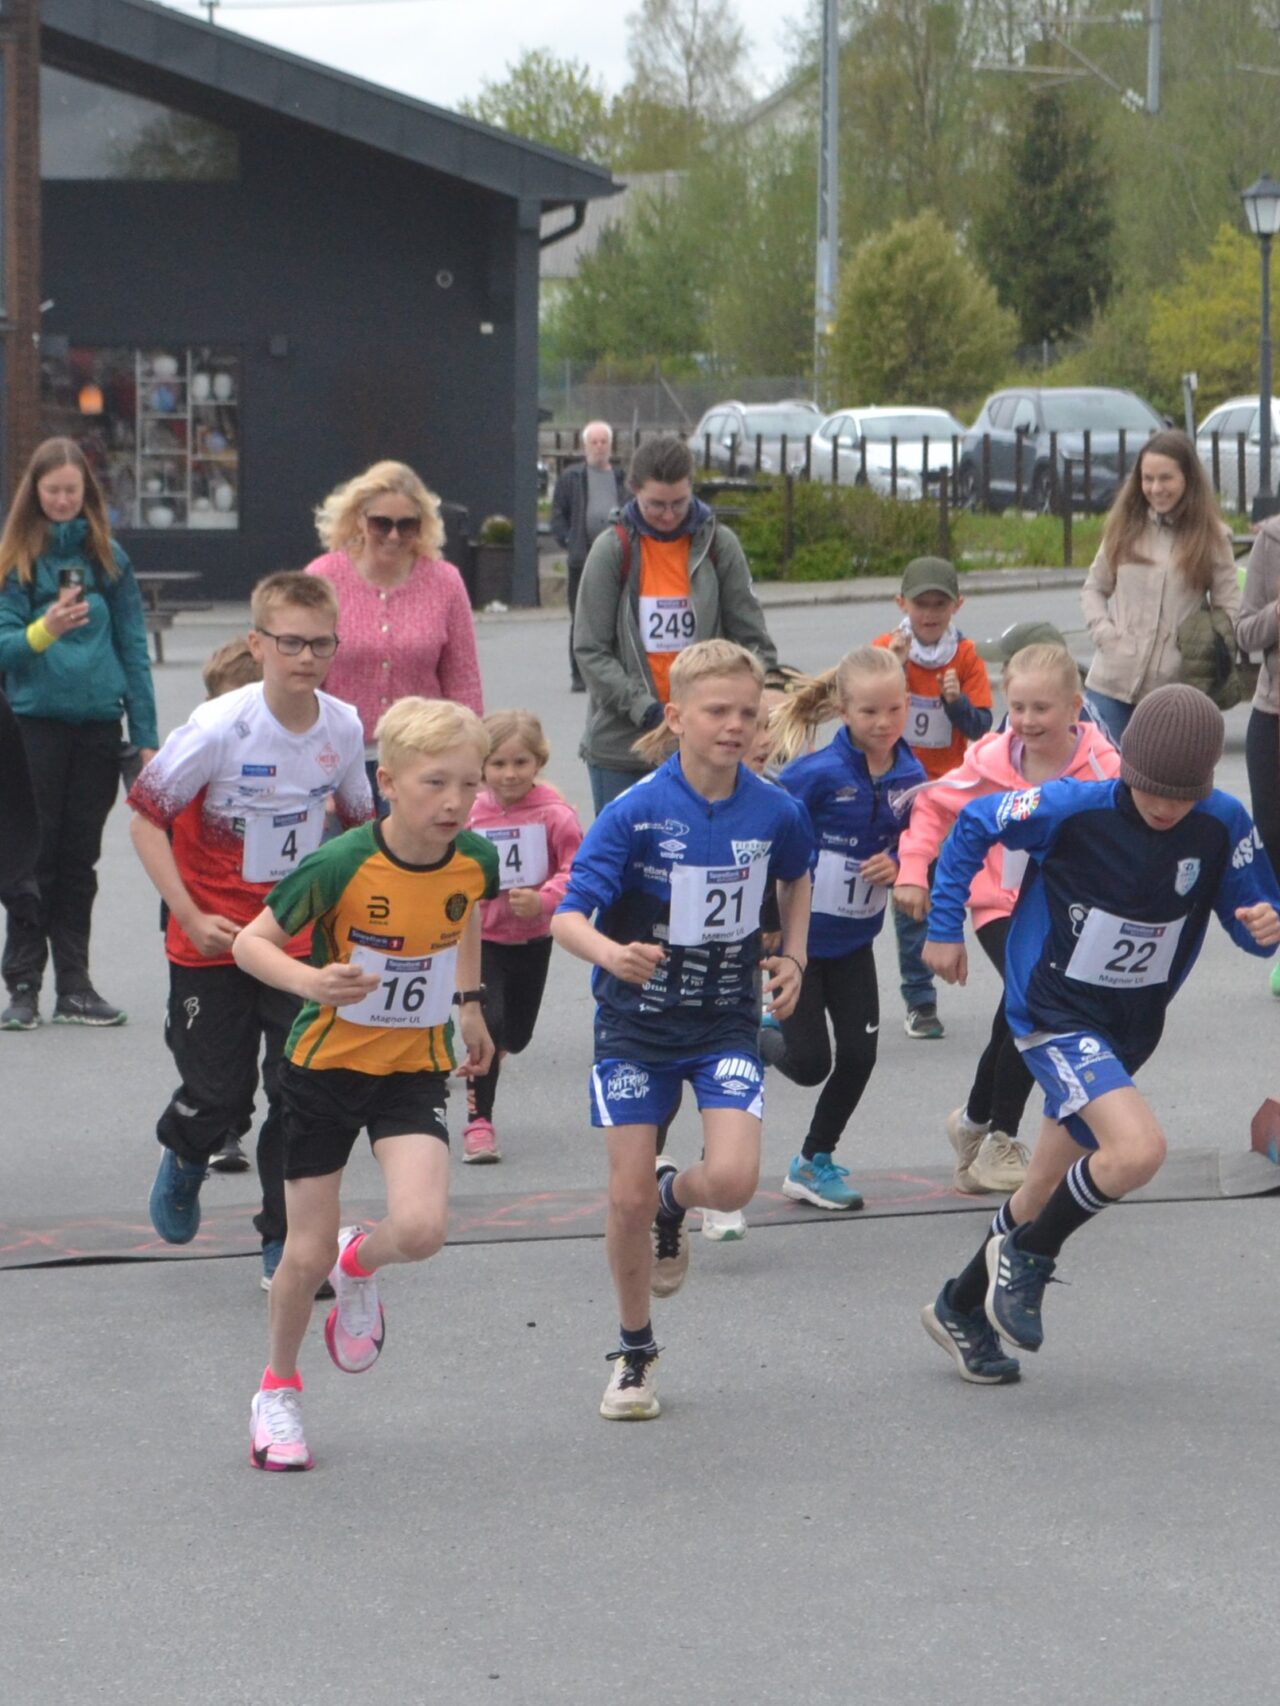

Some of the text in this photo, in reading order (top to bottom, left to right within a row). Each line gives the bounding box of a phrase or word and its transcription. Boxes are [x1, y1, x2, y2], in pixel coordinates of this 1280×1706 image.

[649, 610, 695, 638] 249
[914, 712, 929, 737] 9
[281, 829, 297, 861] 4
[505, 844, 522, 872] 4
[844, 877, 873, 905] 17
[704, 886, 744, 927] 21
[1105, 939, 1157, 973] 22
[382, 976, 427, 1012] 16
[370, 1015, 407, 1024] Magnor
